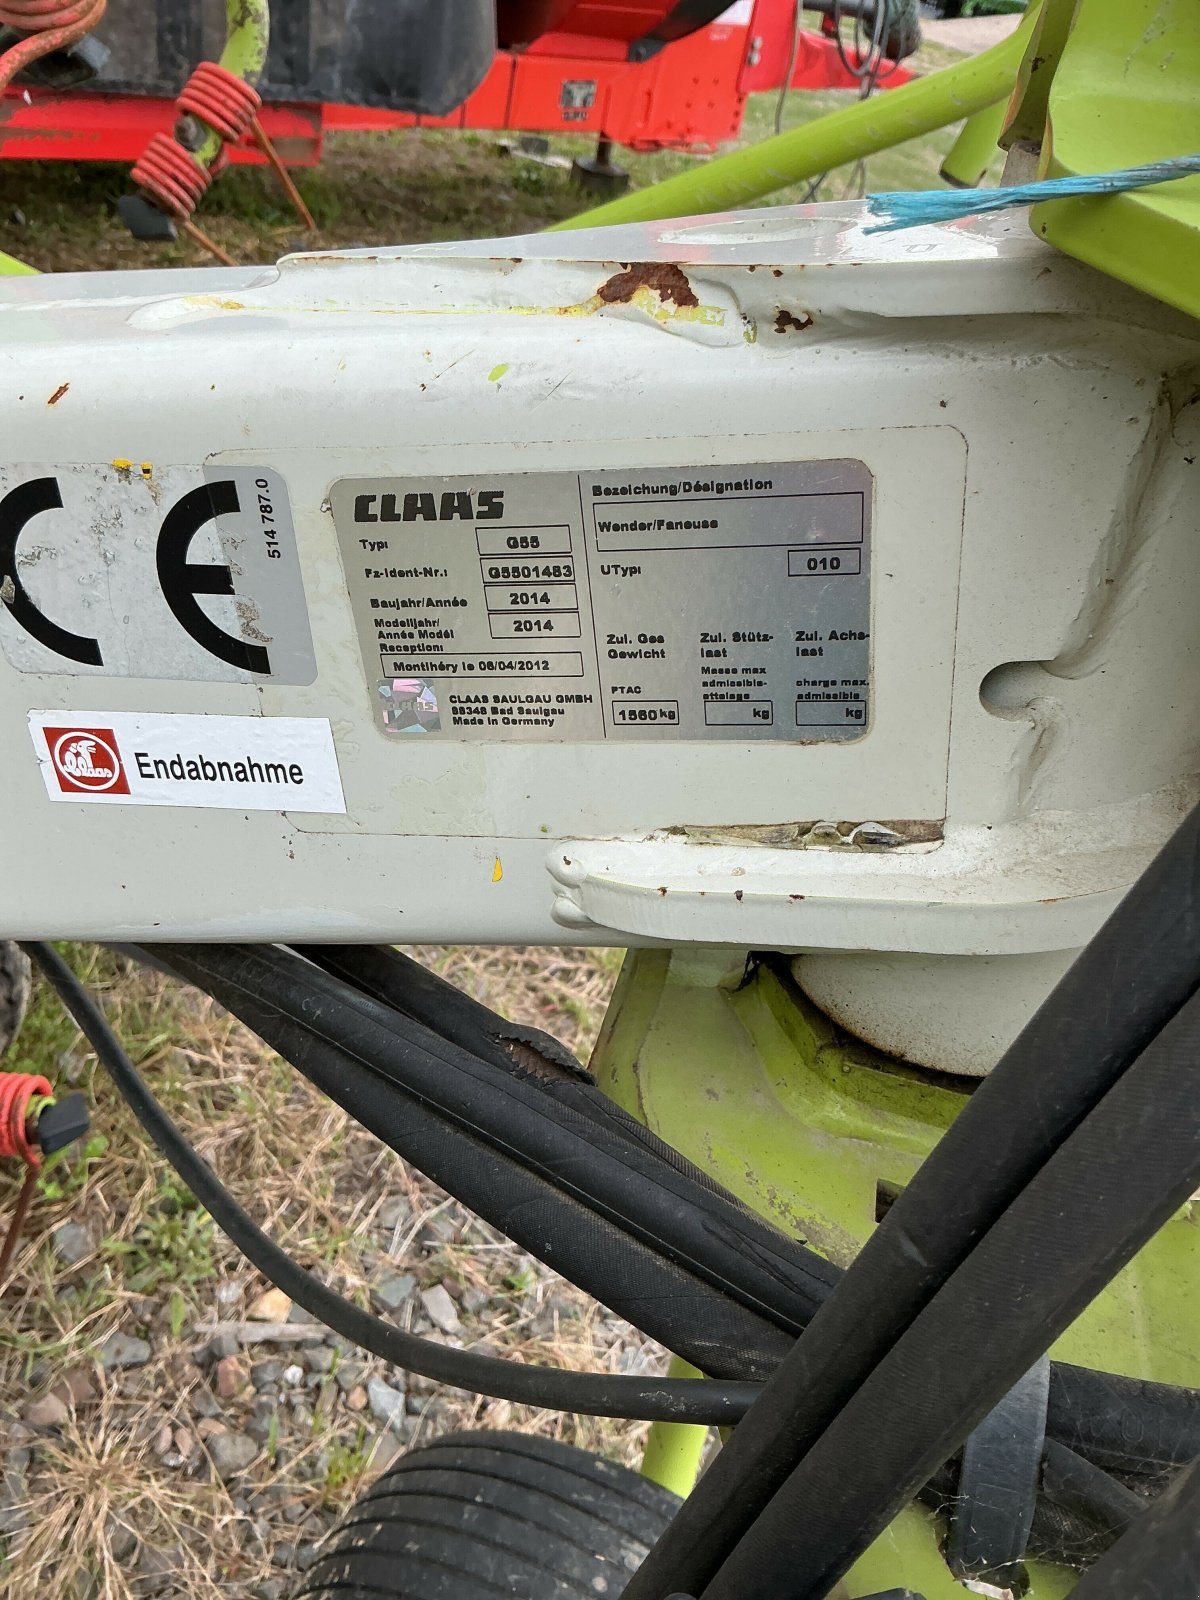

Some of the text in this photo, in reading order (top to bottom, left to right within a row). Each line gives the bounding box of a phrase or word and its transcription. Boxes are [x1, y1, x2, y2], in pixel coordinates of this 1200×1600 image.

[354, 490, 504, 522] CLAAS
[255, 478, 281, 559] 514 787.0
[598, 519, 719, 532] Wender/Faneuse
[506, 535, 540, 549] G55
[807, 557, 841, 570] 010
[488, 564, 573, 579] G5501483
[370, 596, 468, 610] Baujahr/Année
[509, 591, 551, 605] 2014
[512, 619, 554, 632] 2014
[378, 629, 415, 640] Année
[606, 633, 665, 645] Zul. Ges
[700, 632, 727, 644] Zul.
[795, 630, 823, 642] Zul.
[607, 648, 666, 660] Gewicht
[700, 647, 728, 659] last
[795, 646, 824, 657] last
[462, 661, 475, 671] le
[741, 667, 767, 675] max
[611, 686, 642, 695] PTAC
[449, 694, 593, 704] CLAAS SAULGAU GMBH
[490, 706, 514, 715] Bad
[516, 706, 565, 717] Saulgau
[659, 708, 676, 720] kg
[752, 708, 770, 720] kg
[845, 707, 863, 719] kg
[452, 716, 555, 727] Made in Germany
[134, 752, 304, 785] Endabnahme
